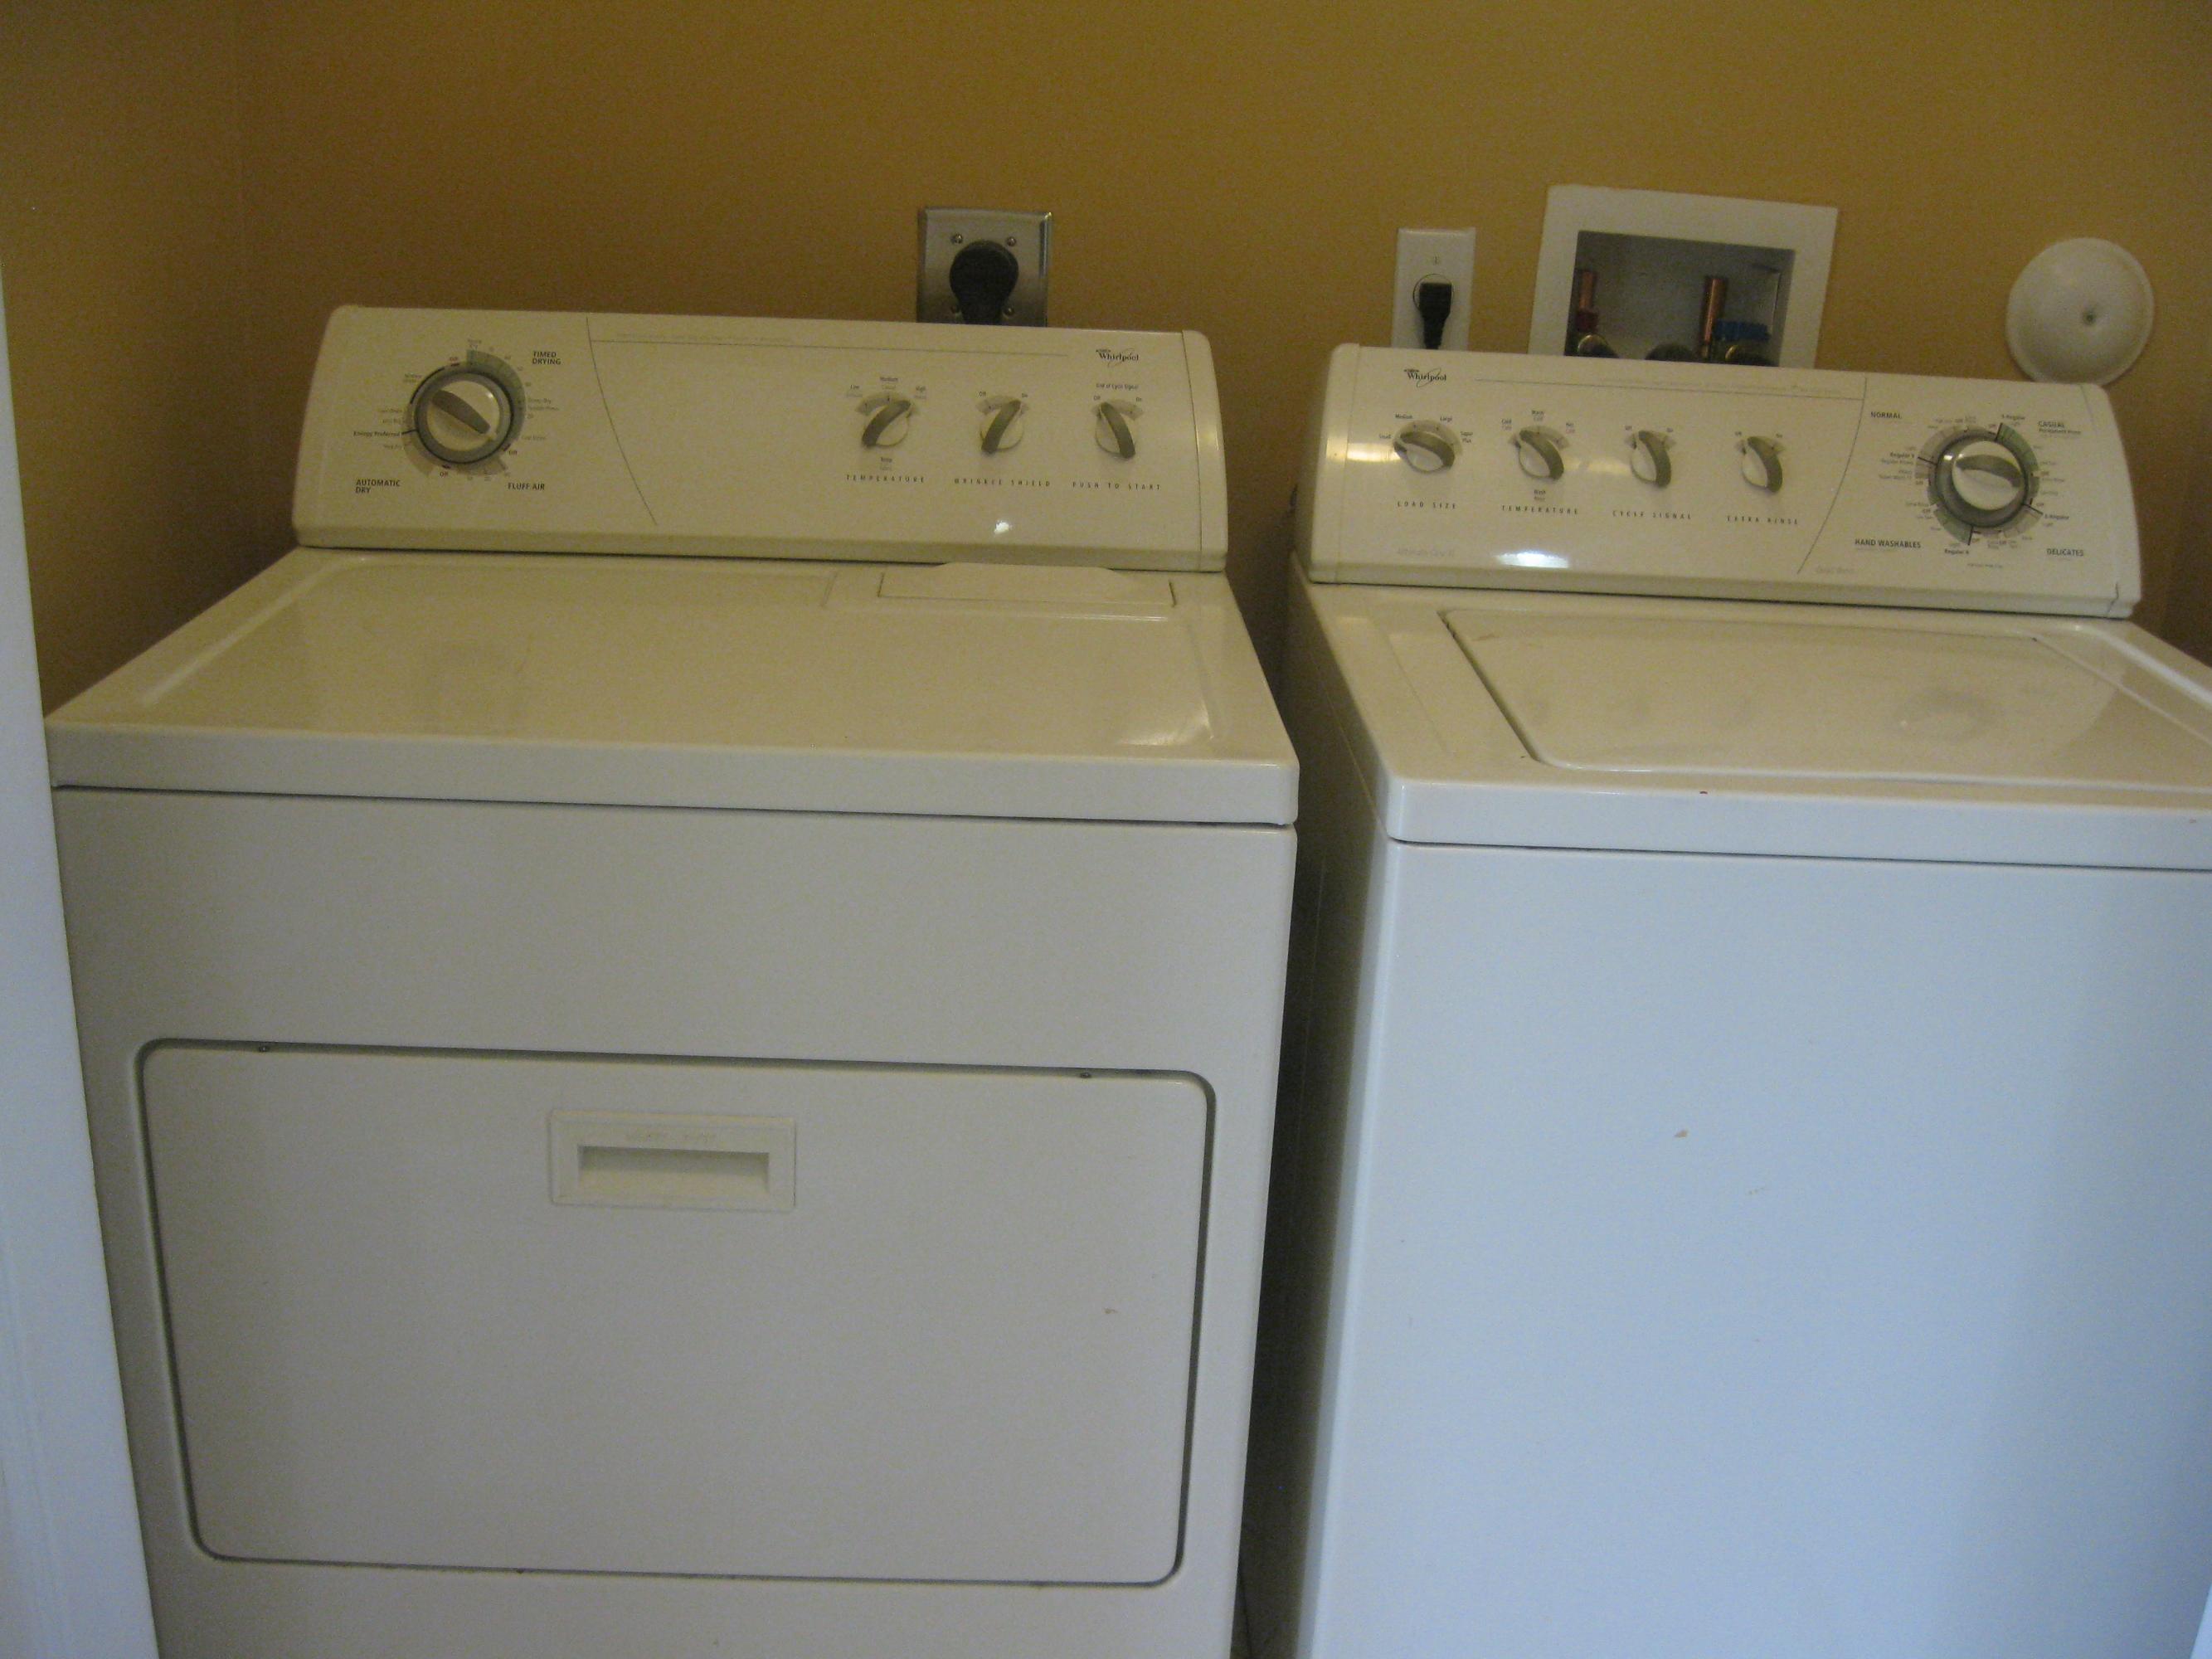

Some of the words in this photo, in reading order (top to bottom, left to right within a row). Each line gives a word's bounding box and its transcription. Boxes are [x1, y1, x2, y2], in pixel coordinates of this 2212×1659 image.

[532, 350, 557, 358] TIMED
[1098, 350, 1140, 362] Whirlpool
[532, 358, 562, 366] DRYING
[1407, 371, 1447, 382] Whirlpool
[355, 479, 401, 488] AUTOMATIC
[846, 474, 924, 483] TEMPERATURE
[954, 478, 1002, 486] WRINKLE
[1011, 479, 1050, 487] SHIELD
[1397, 500, 1424, 508] LOAD
[1432, 501, 1456, 509] SIZE
[1501, 504, 1578, 515] TEMPERATURE
[1612, 509, 1644, 518] CYCLE
[1652, 512, 1691, 520] SIGNAL
[1727, 514, 1759, 523] EXTRA
[1767, 517, 1797, 525] RINSE
[1855, 538, 1876, 547] HAND
[1878, 539, 1921, 549] WASHABLES
[2046, 547, 2084, 557] DELICATES
